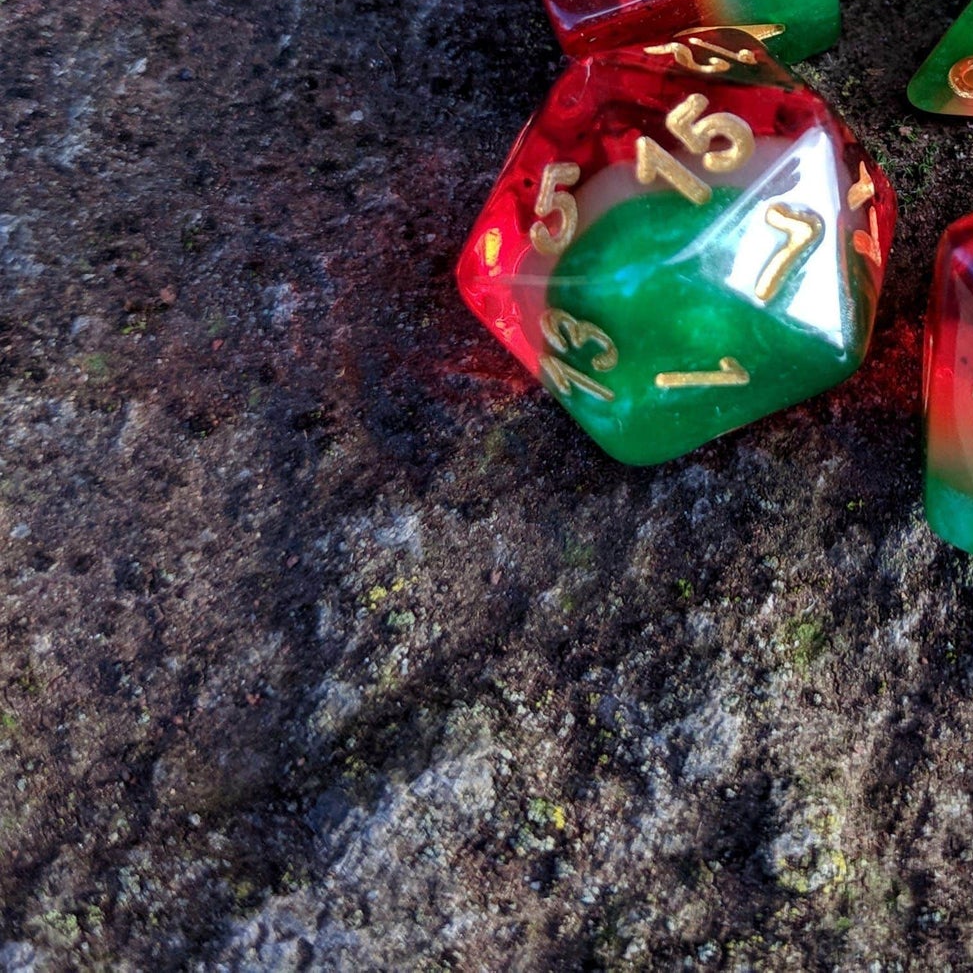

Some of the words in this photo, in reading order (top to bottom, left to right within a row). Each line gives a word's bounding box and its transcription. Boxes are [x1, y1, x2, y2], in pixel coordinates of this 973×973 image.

[635, 93, 756, 205] 15
[529, 162, 581, 256] 5
[754, 202, 826, 302] 7
[538, 308, 620, 402] 13
[654, 356, 751, 389] 1
